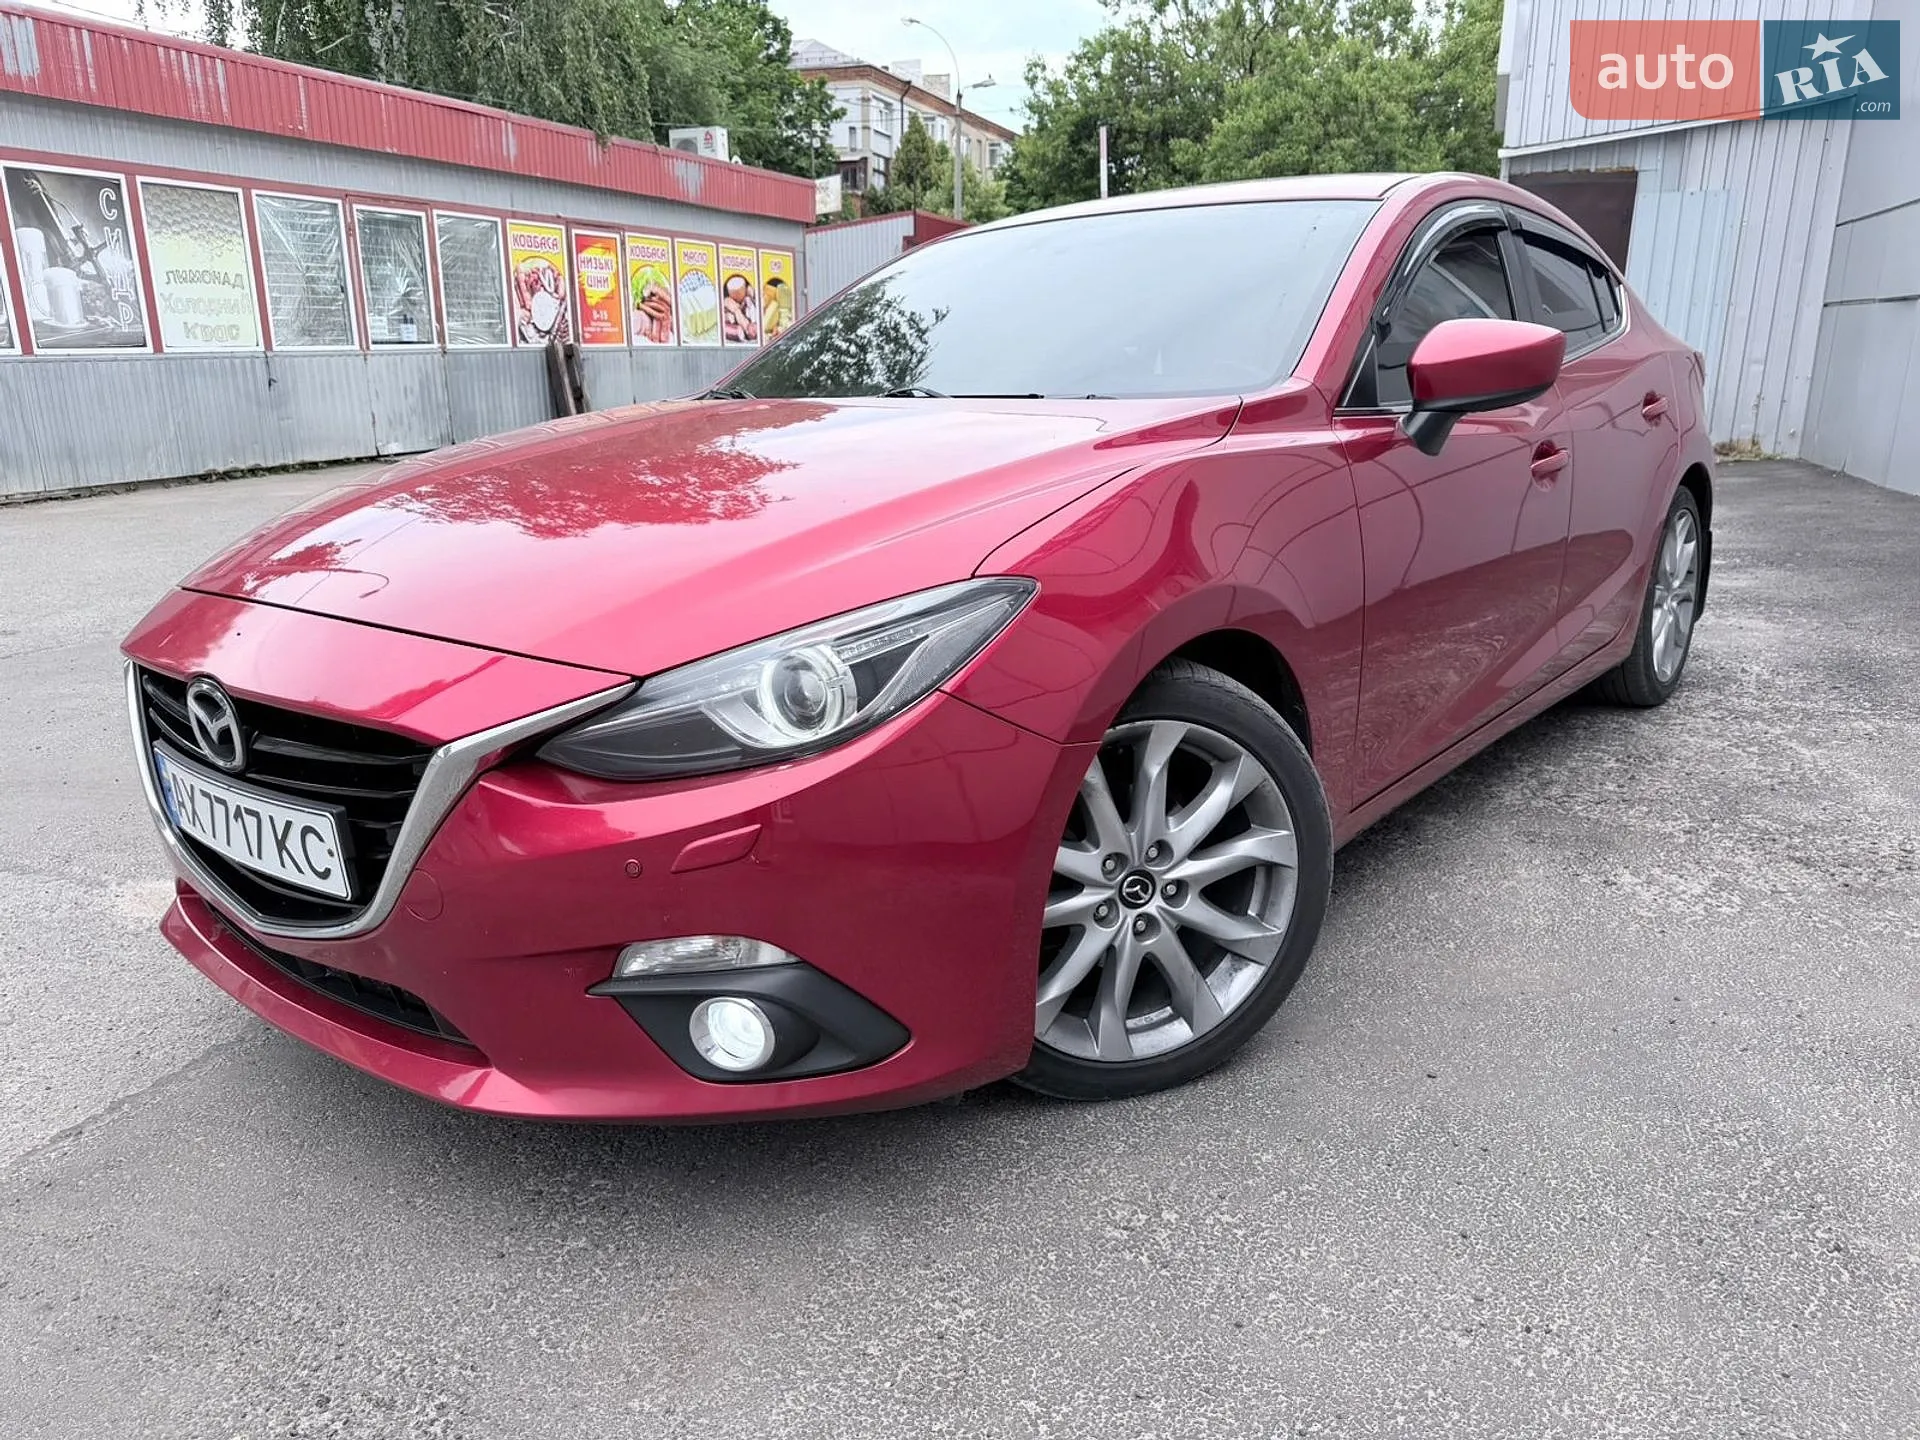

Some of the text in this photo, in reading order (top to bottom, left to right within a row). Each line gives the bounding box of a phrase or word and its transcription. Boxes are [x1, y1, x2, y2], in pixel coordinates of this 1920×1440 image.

[512, 233, 559, 251] КОВБАСА
[99, 187, 135, 332] СИДР
[629, 244, 666, 260] КОВБАСА
[682, 250, 707, 264] МАСЛО
[579, 255, 614, 271] НИЗЬКІ
[165, 269, 245, 290] ЛИМОНАД
[586, 275, 609, 289] ЦІНИ
